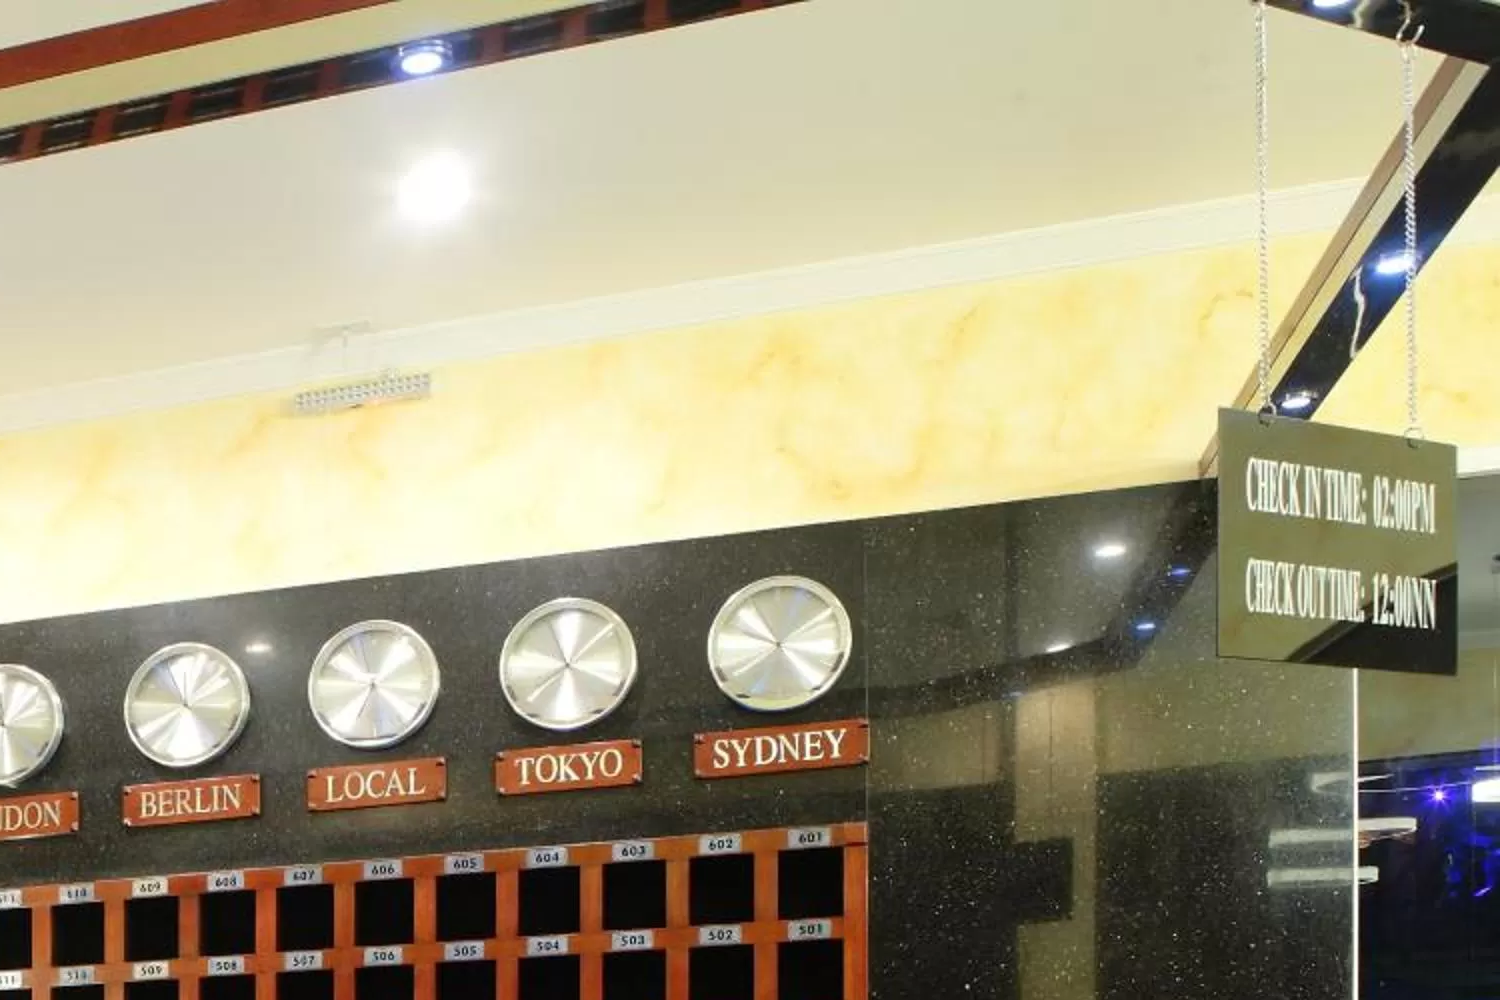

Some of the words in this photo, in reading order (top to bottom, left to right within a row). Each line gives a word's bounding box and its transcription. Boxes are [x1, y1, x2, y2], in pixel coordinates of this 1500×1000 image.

[1246, 457, 1301, 516] CHECK
[1305, 465, 1323, 519] IN
[1324, 469, 1367, 525] TIME:
[1373, 476, 1436, 534] 02:00PM
[1245, 557, 1296, 616] CHECK
[1372, 572, 1437, 630] 12:00NN
[713, 728, 847, 769] SYDNEY
[514, 748, 623, 785] TOKYO
[325, 767, 426, 804] LOCAL
[139, 783, 242, 819] BERLIN
[798, 831, 823, 844] 601
[708, 838, 734, 851] 602
[621, 845, 646, 857] 603
[453, 857, 477, 870] 605
[535, 851, 560, 864] 604
[292, 870, 315, 882] 607
[371, 864, 395, 876] 606
[140, 881, 161, 893] 609
[215, 876, 238, 888] 608
[708, 929, 734, 941] 502
[799, 923, 823, 935] 501
[536, 940, 560, 952] 504
[621, 934, 646, 946] 503
[372, 950, 395, 962] 506
[453, 945, 477, 957] 505
[216, 960, 238, 972] 508
[292, 955, 316, 967] 507
[140, 964, 163, 977] 509
